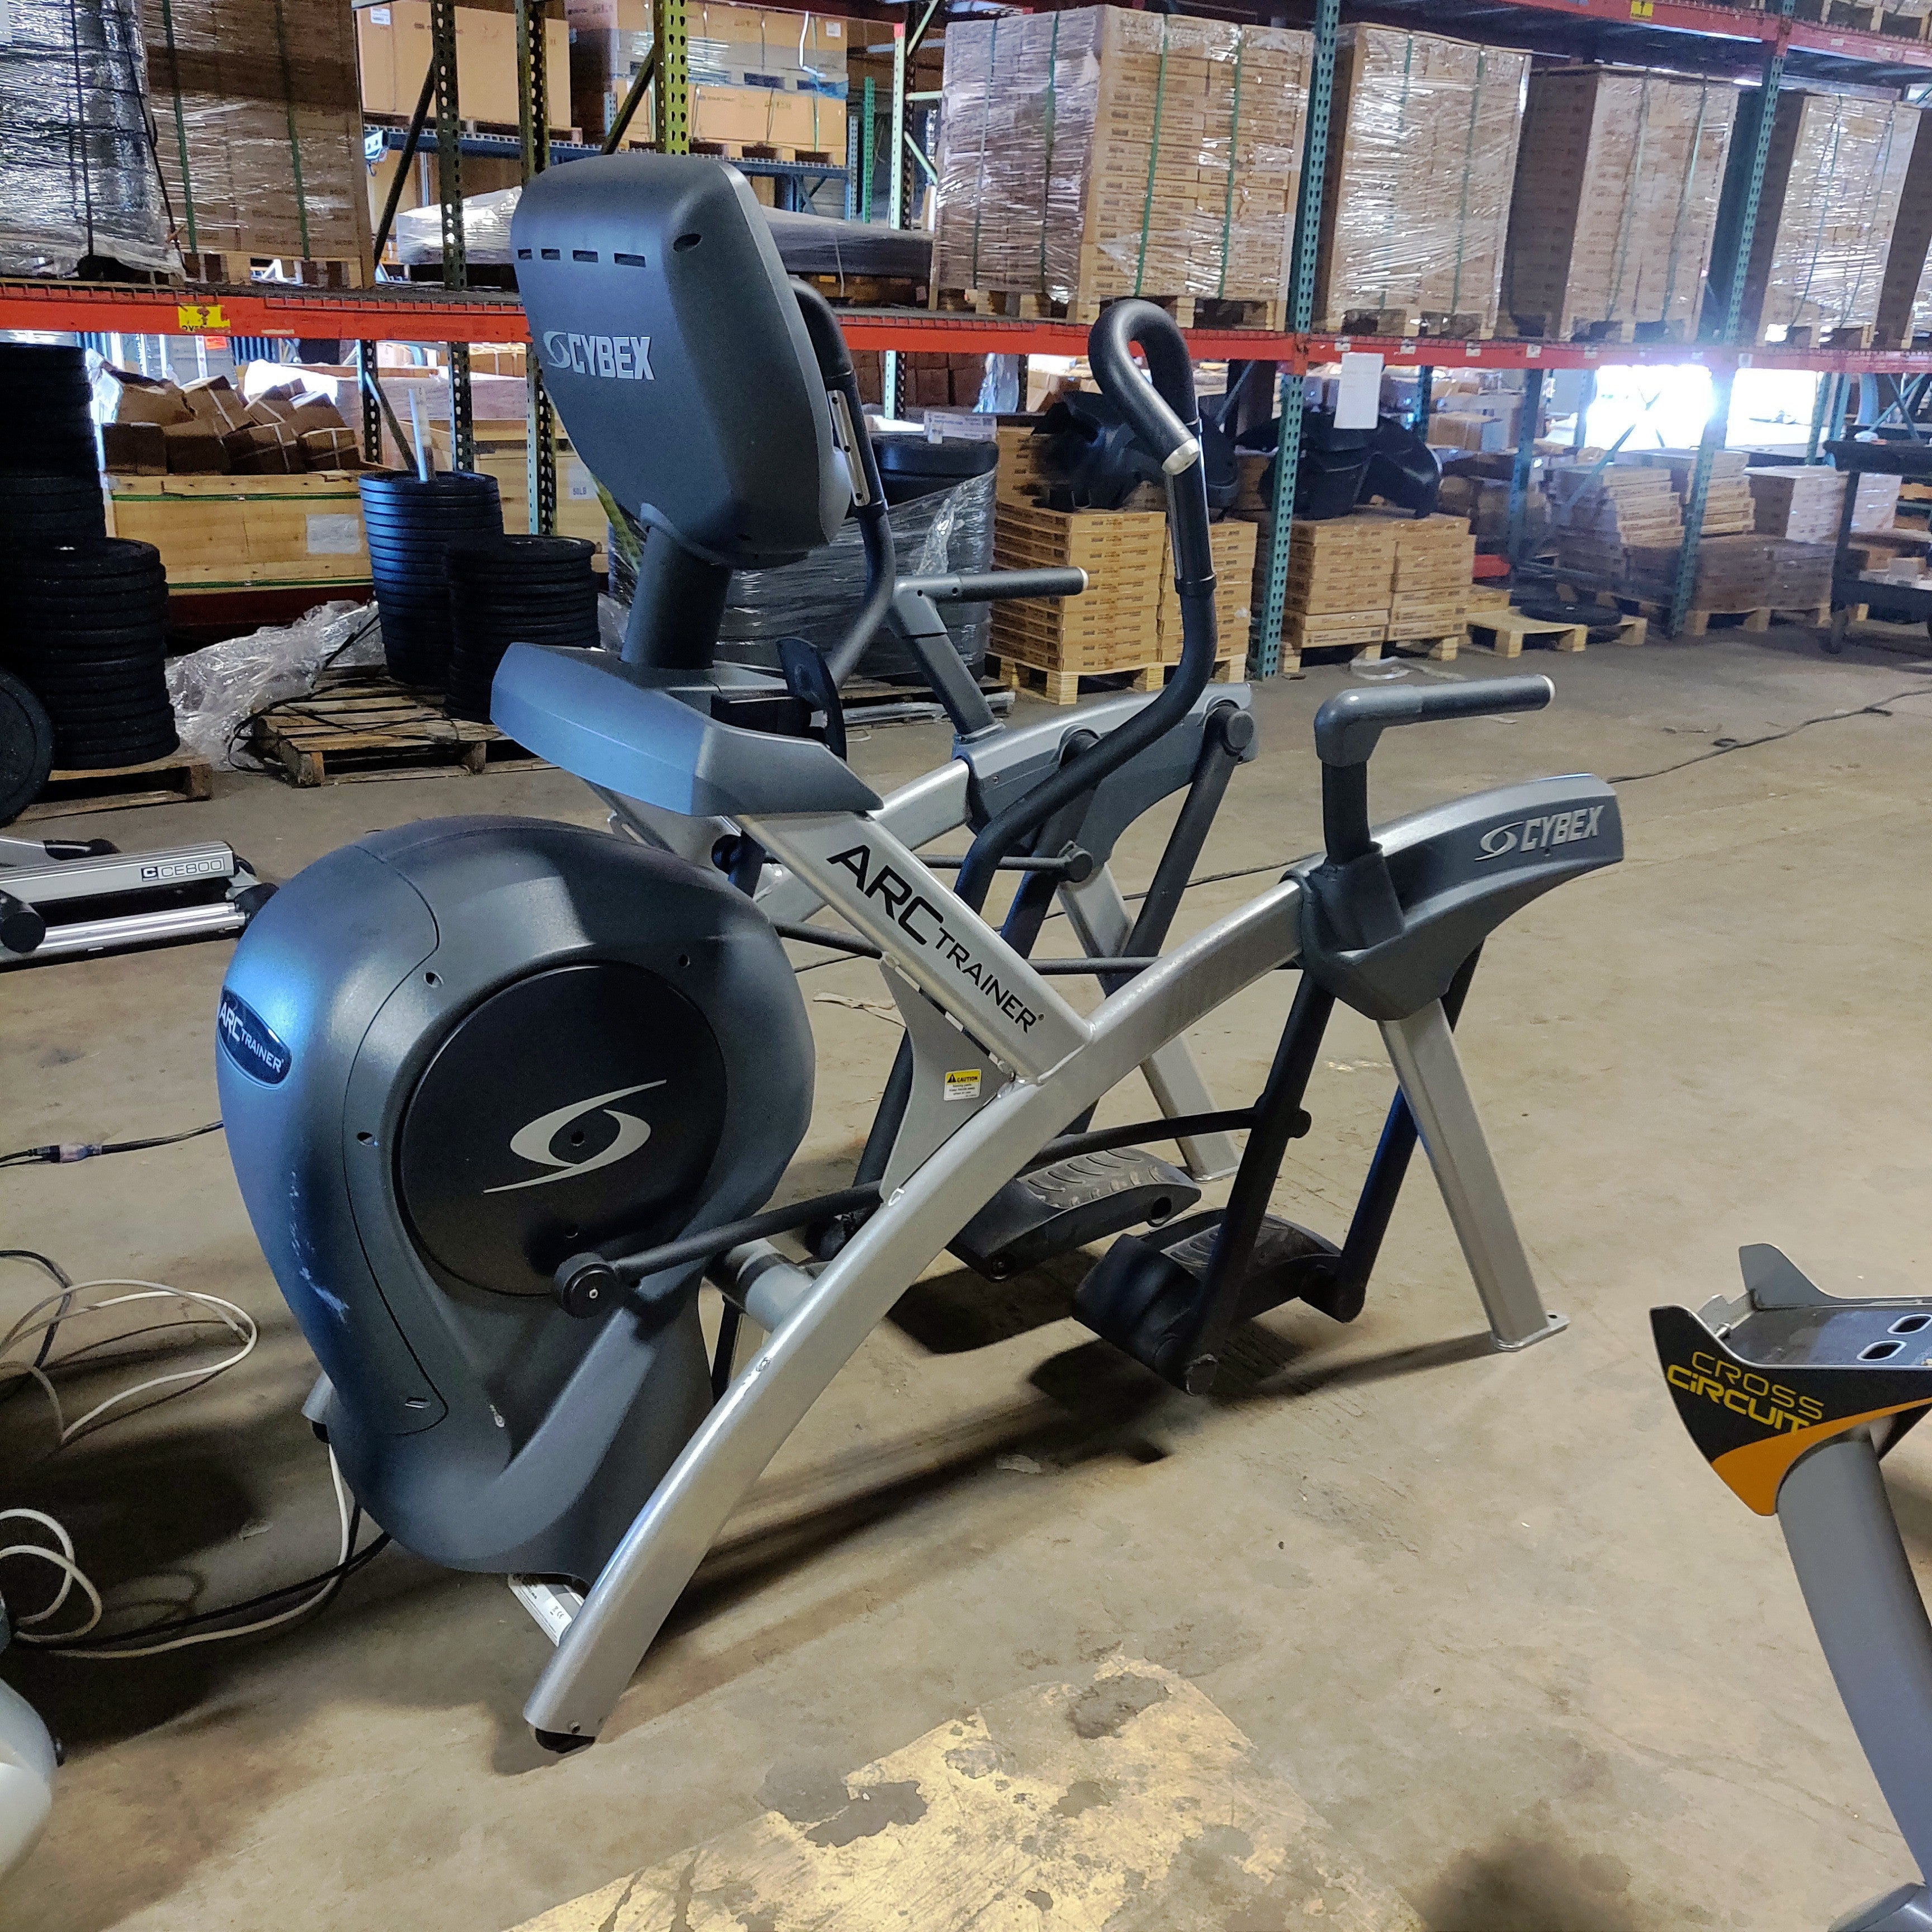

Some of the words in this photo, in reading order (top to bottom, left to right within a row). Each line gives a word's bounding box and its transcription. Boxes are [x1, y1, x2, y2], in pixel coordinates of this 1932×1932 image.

[567, 333, 655, 380] CYBEX
[1520, 805, 1604, 853] CYBEX
[161, 860, 222, 877] CE800
[826, 845, 944, 945] ARC
[219, 1001, 243, 1041] ARC
[1692, 1351, 1824, 1420] CROSS
